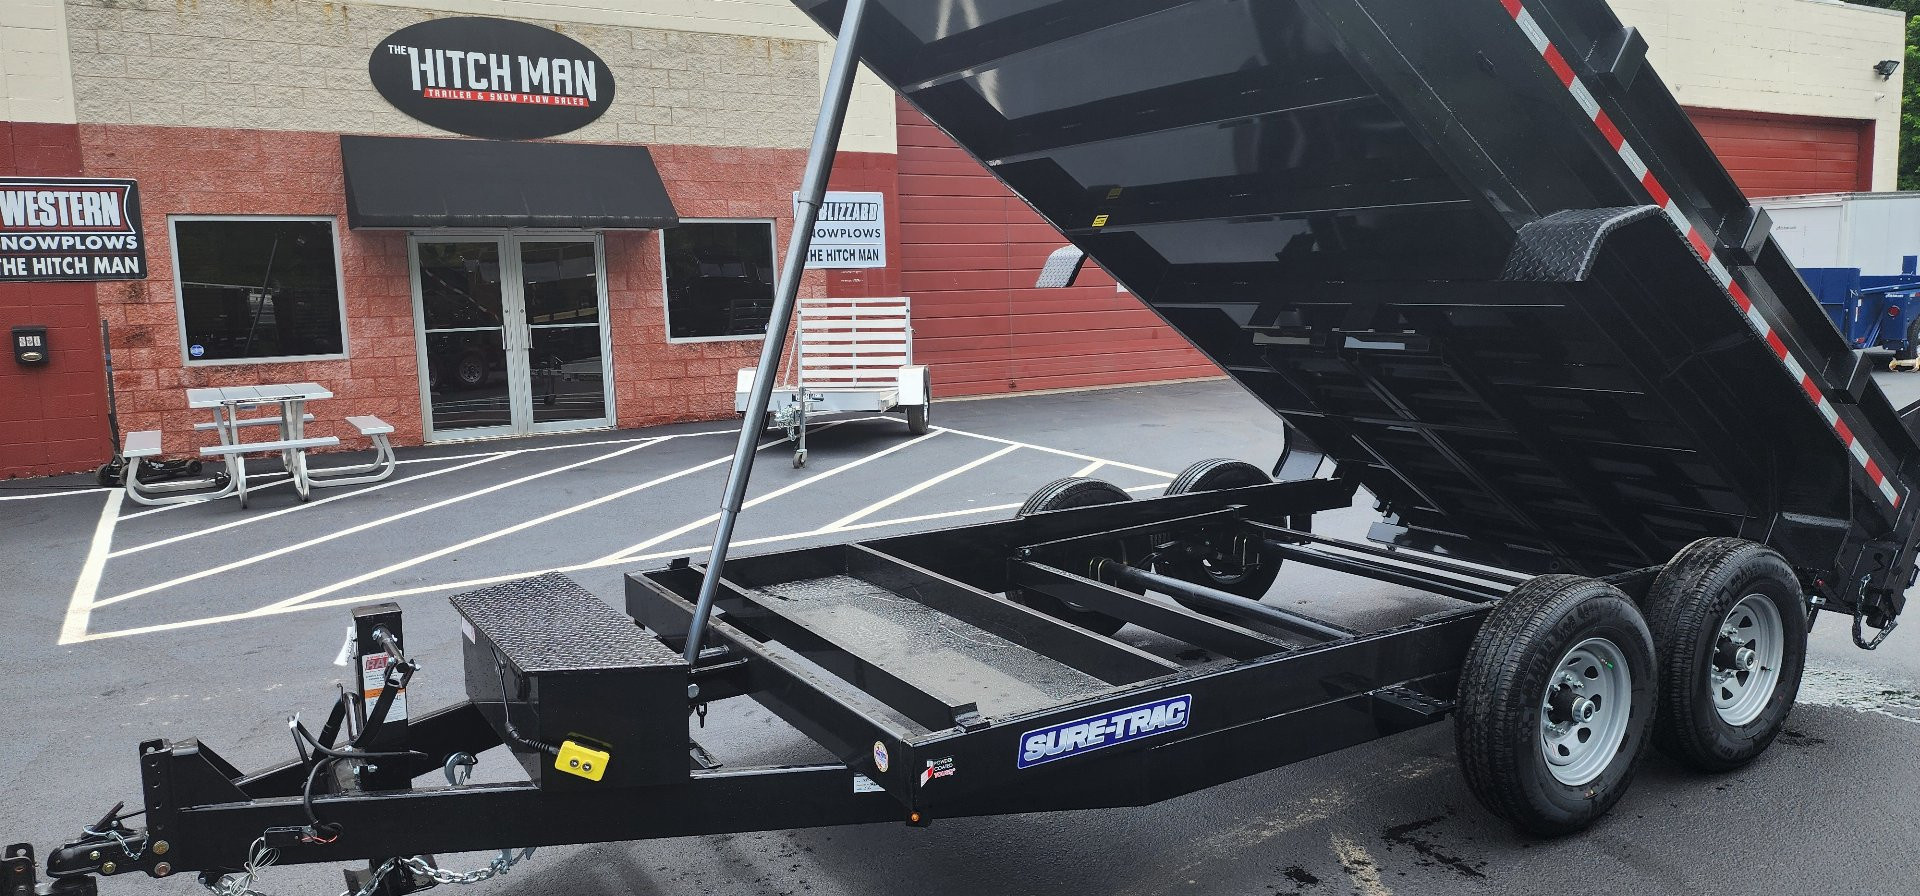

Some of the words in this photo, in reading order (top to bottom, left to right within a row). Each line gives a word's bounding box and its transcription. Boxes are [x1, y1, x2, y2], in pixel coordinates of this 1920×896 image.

[387, 44, 407, 55] THE
[408, 47, 512, 91] HITCH
[518, 55, 597, 101] MAN
[428, 89, 472, 99] TRAILER
[477, 92, 485, 100] &
[490, 93, 517, 102] SNOW
[523, 95, 549, 104] PLOW
[554, 96, 584, 106] SALES
[0, 190, 121, 226] WESTERN
[0, 235, 138, 250] NOWPLOWS
[806, 249, 823, 262] HE
[826, 249, 856, 262] HITCH
[859, 248, 879, 261] MAN
[33, 257, 88, 275] HITCH
[94, 256, 139, 274] MAN
[1024, 700, 1187, 762] SURE-TRAC
